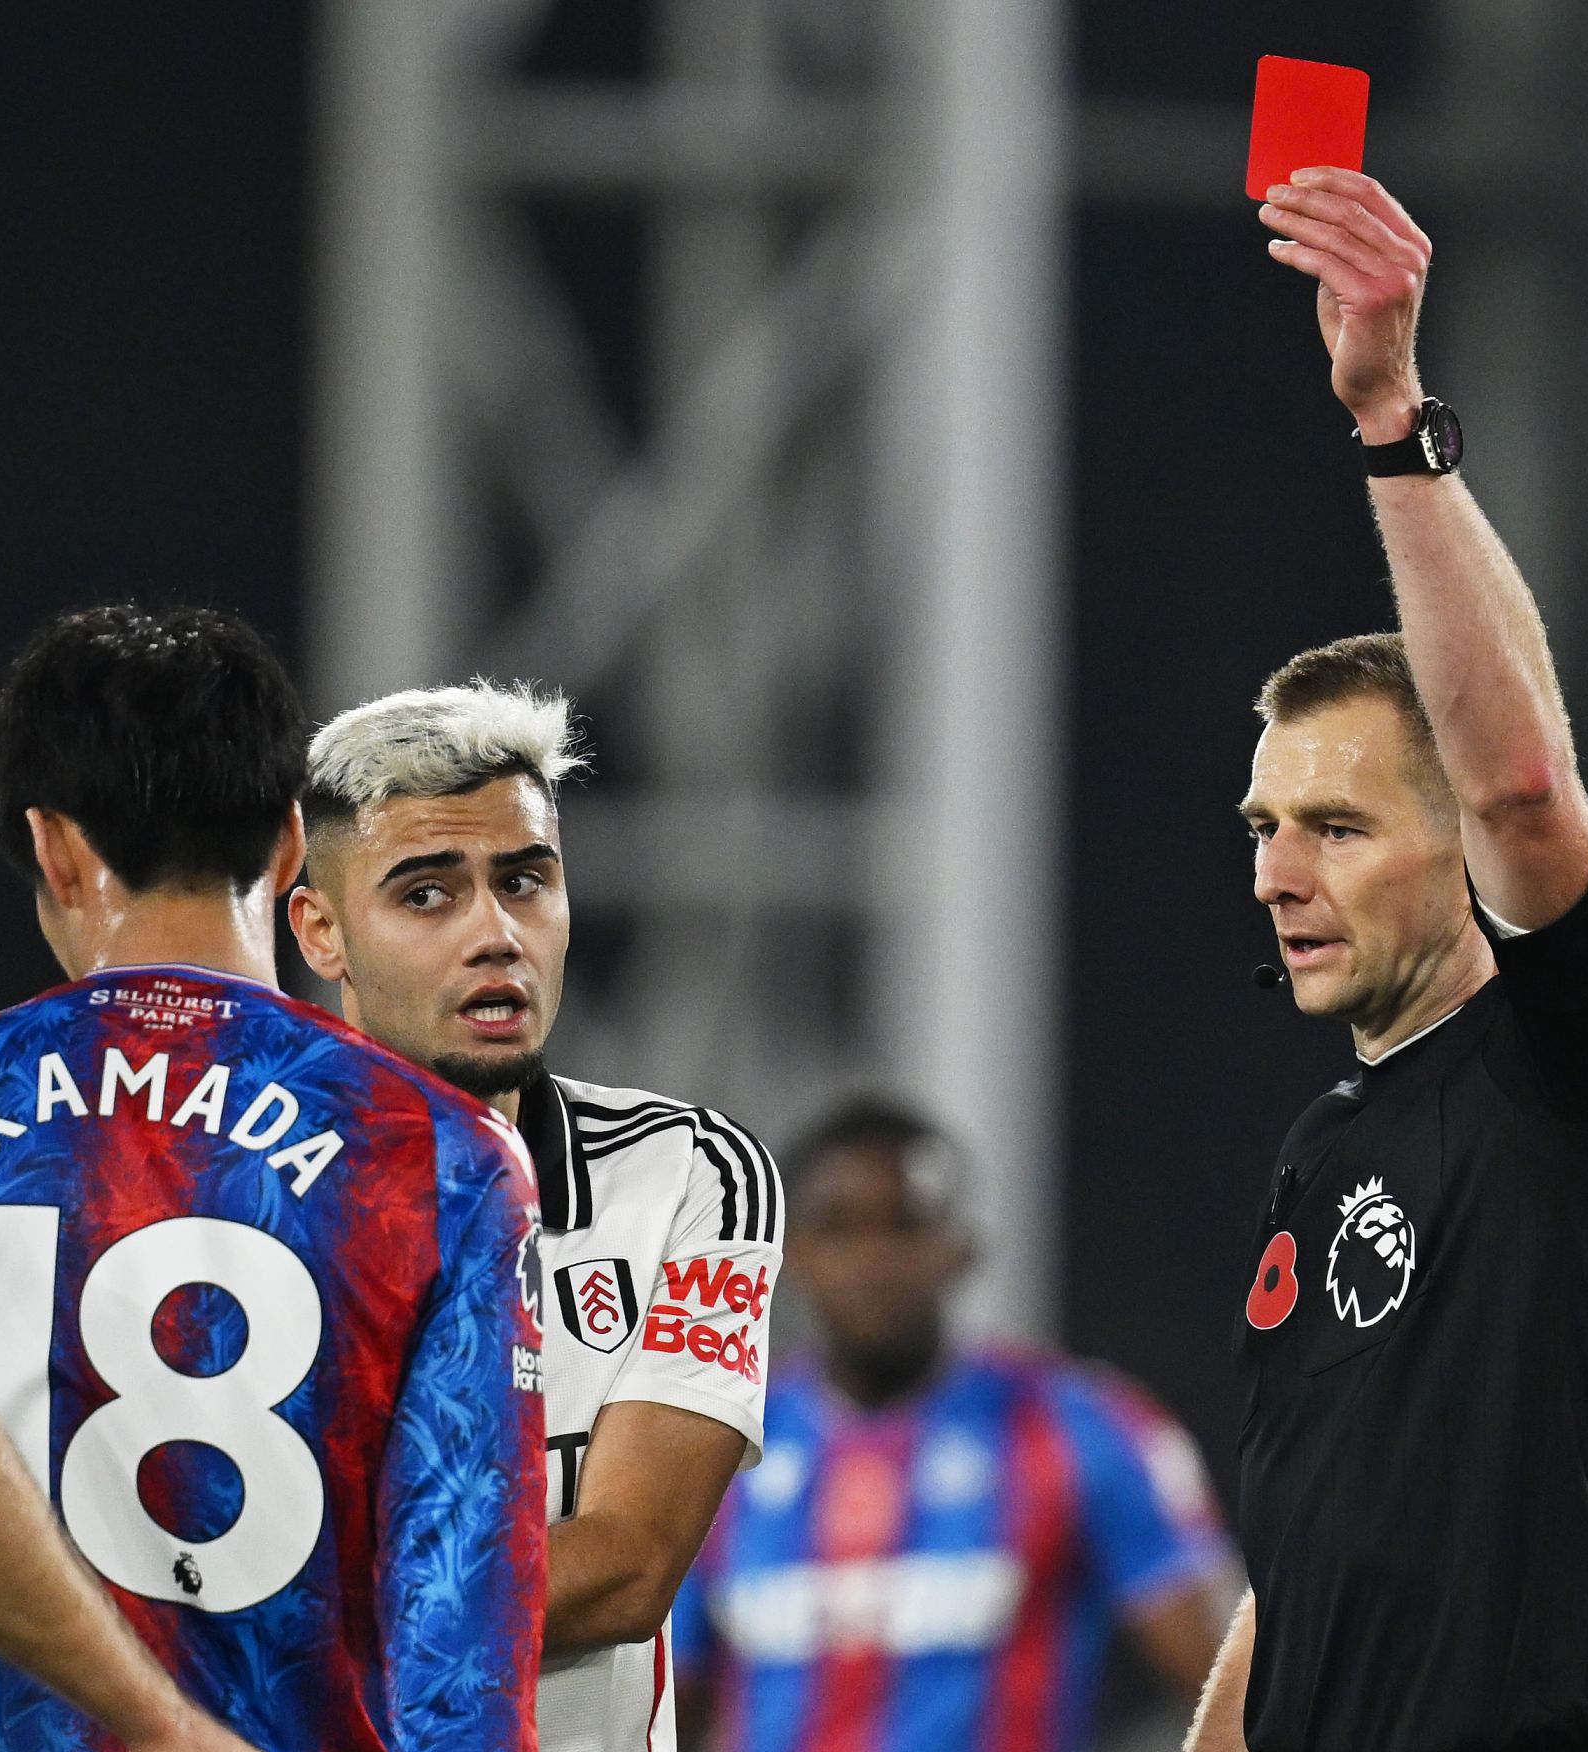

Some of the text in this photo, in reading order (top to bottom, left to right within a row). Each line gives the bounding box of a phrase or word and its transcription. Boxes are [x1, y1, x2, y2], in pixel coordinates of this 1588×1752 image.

[88, 989, 241, 1019] SELHURST
[129, 1007, 194, 1026] PARK
[578, 1269, 619, 1335] FFC
[642, 1304, 761, 1385] Beds
